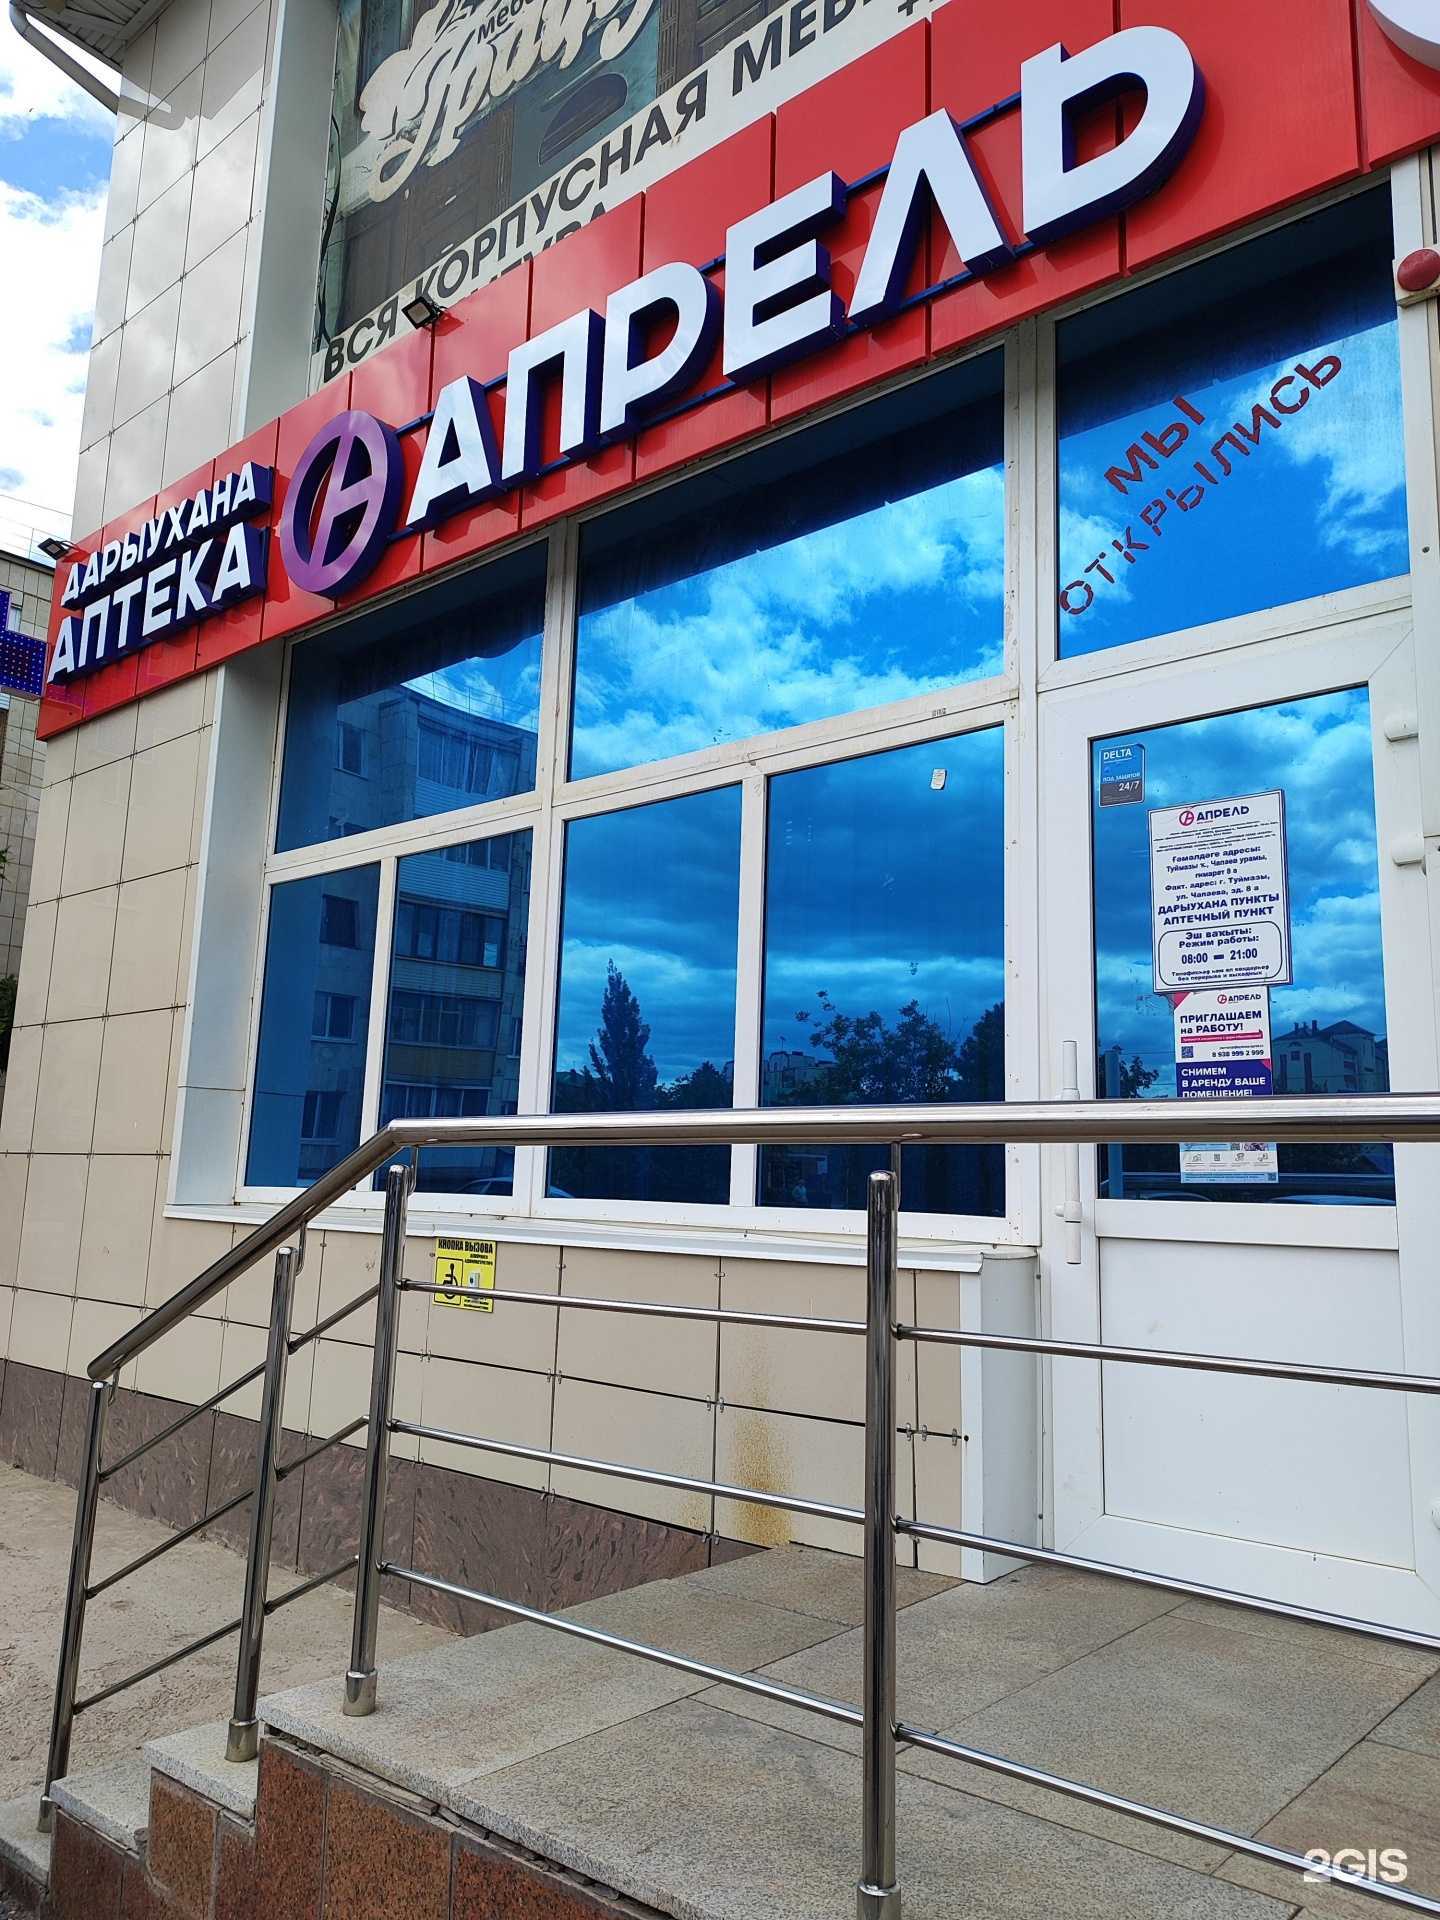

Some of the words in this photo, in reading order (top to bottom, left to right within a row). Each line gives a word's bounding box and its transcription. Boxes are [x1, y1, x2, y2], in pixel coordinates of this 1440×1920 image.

[324, 295, 399, 384] ВСЯ
[414, 69, 709, 303] КОРПУСНАЯ
[406, 25, 1199, 530] АПРЕЛЬ
[1103, 395, 1206, 495] МЫ
[1059, 354, 1342, 615] ОТКРЫЛИСЬ
[60, 461, 258, 608] ДАРЫУХАНА
[46, 524, 252, 685] АПТЕКА
[1103, 748, 1132, 760] DELTA
[1118, 780, 1140, 792] 24/7
[1196, 806, 1250, 822] АПРЕЛЬ
[1158, 899, 1228, 915] ДАРЫУХАНА
[1230, 893, 1280, 906] ПУНКТЫ
[1164, 909, 1230, 926] АПТЕЧНЫЙ
[1234, 906, 1274, 918] ПУНКТ
[1178, 940, 1214, 948] Режим
[1217, 936, 1260, 946] работы:
[1185, 932, 1202, 940] Эш
[1181, 952, 1208, 965] 08:00
[1230, 948, 1258, 960] 21:00
[1228, 994, 1262, 1002] АПРЕЛЬ
[1180, 1010, 1262, 1024] ПРИГЛАШАЕМ
[1180, 1026, 1193, 1034] на
[1196, 1022, 1244, 1034] РАБОТУ!
[1181, 1067, 1227, 1076] СНИМЕМ
[1182, 1080, 1189, 1088] В
[1190, 1078, 1232, 1088] АРЕНДУ
[1234, 1076, 1266, 1086] ВАШЕ
[438, 1239, 464, 1251] КНОПКА
[464, 1241, 493, 1254] ВЫЗОВА
